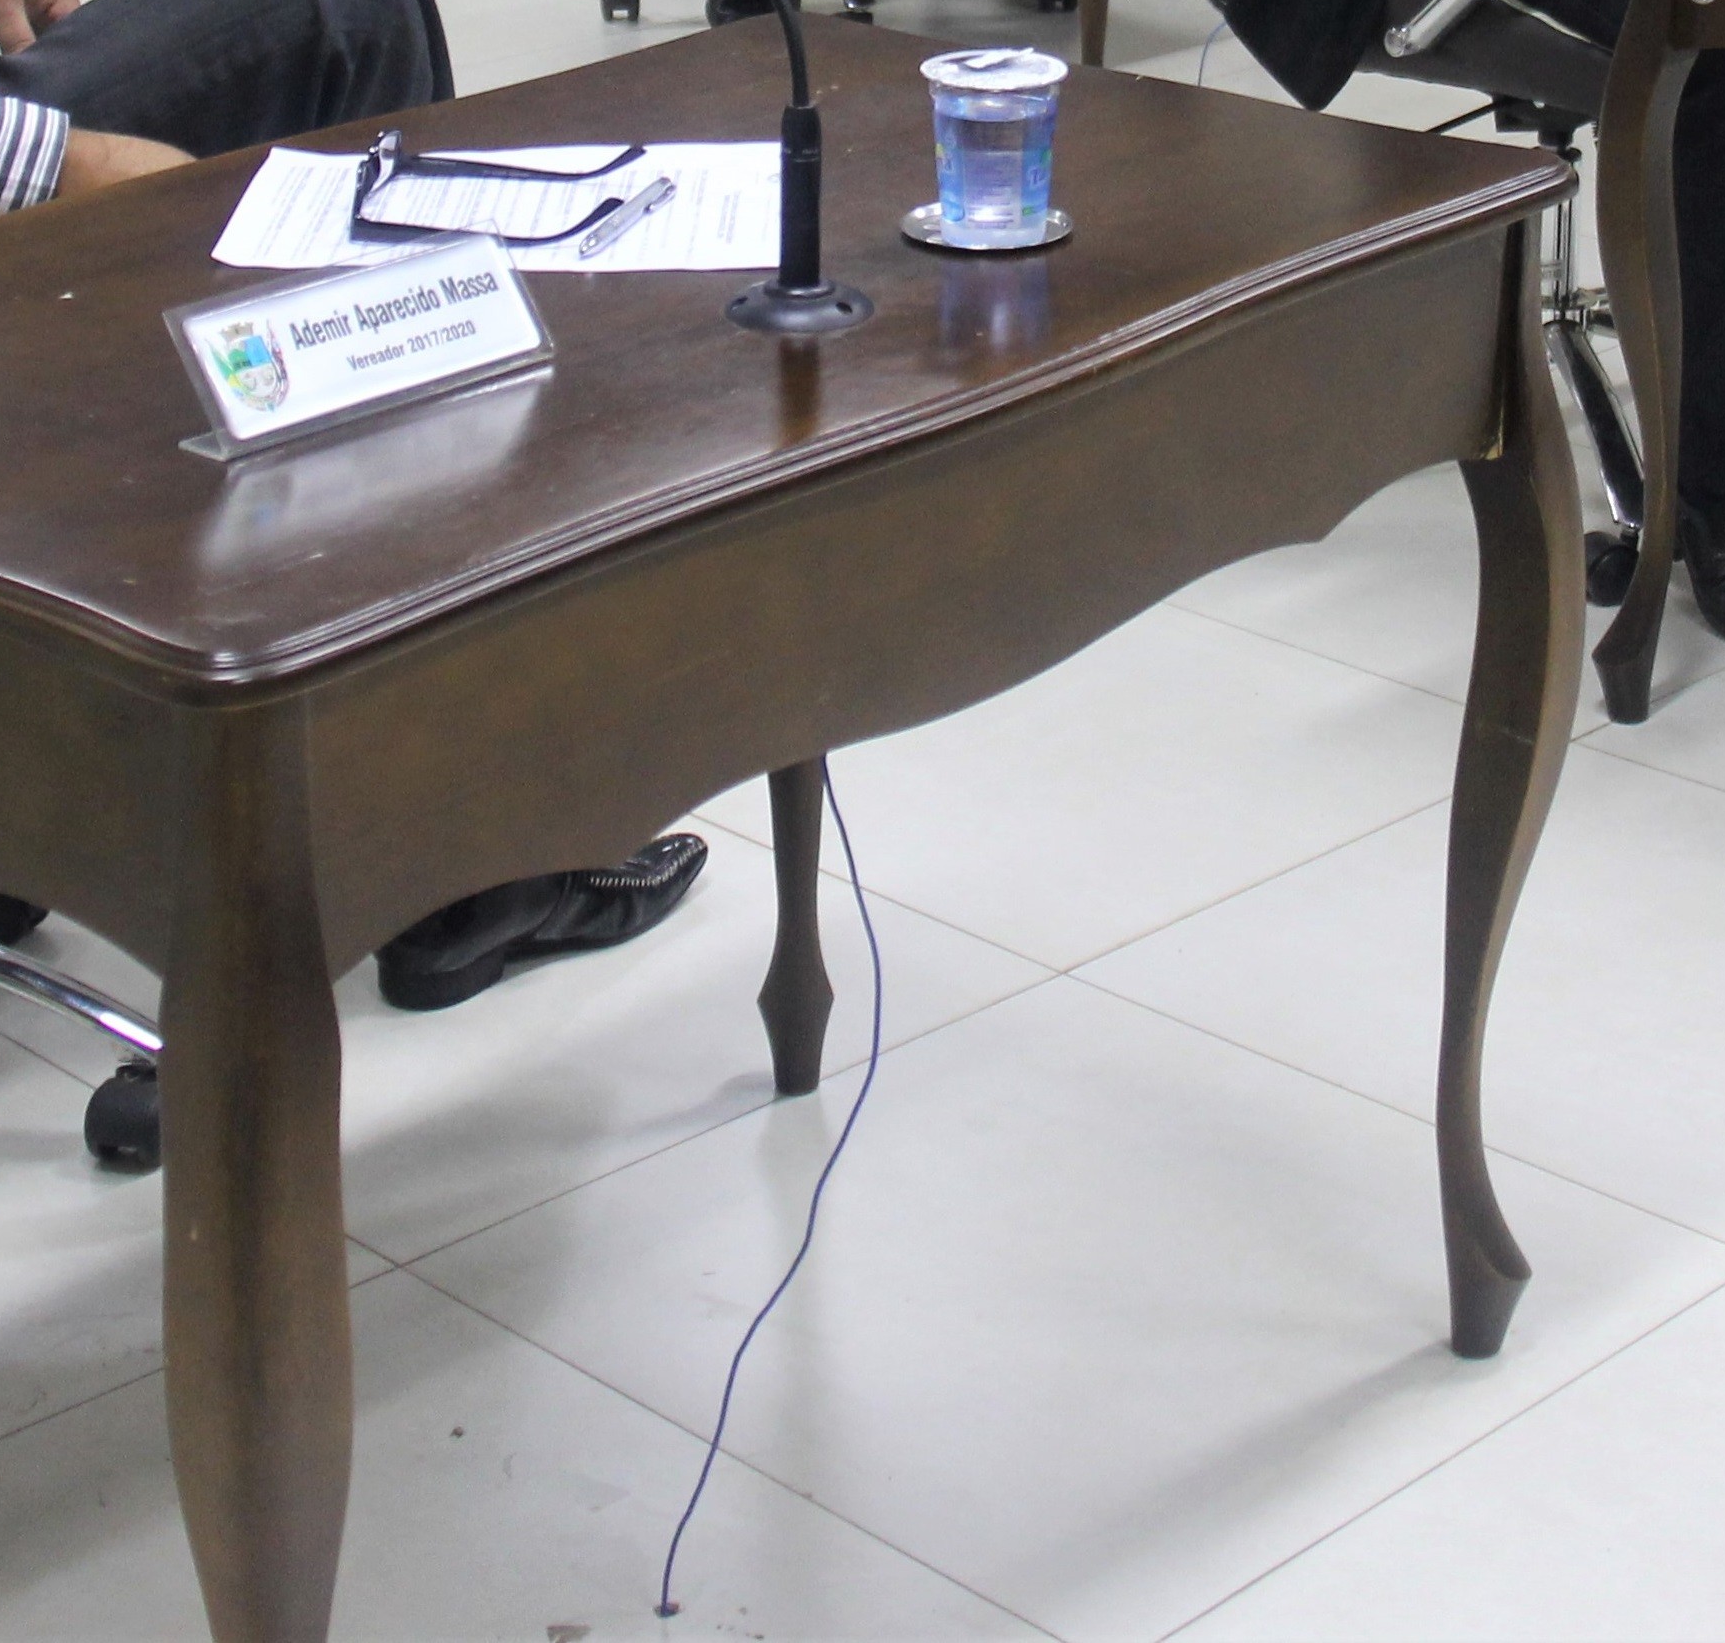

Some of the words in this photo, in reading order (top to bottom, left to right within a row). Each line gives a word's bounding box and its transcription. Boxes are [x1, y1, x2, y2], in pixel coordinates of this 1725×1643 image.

[289, 309, 352, 351] Ademir
[353, 284, 441, 334] Aparecido
[438, 271, 499, 305] Massa
[347, 344, 405, 371] Vereador
[407, 320, 476, 353] 2017/2020
